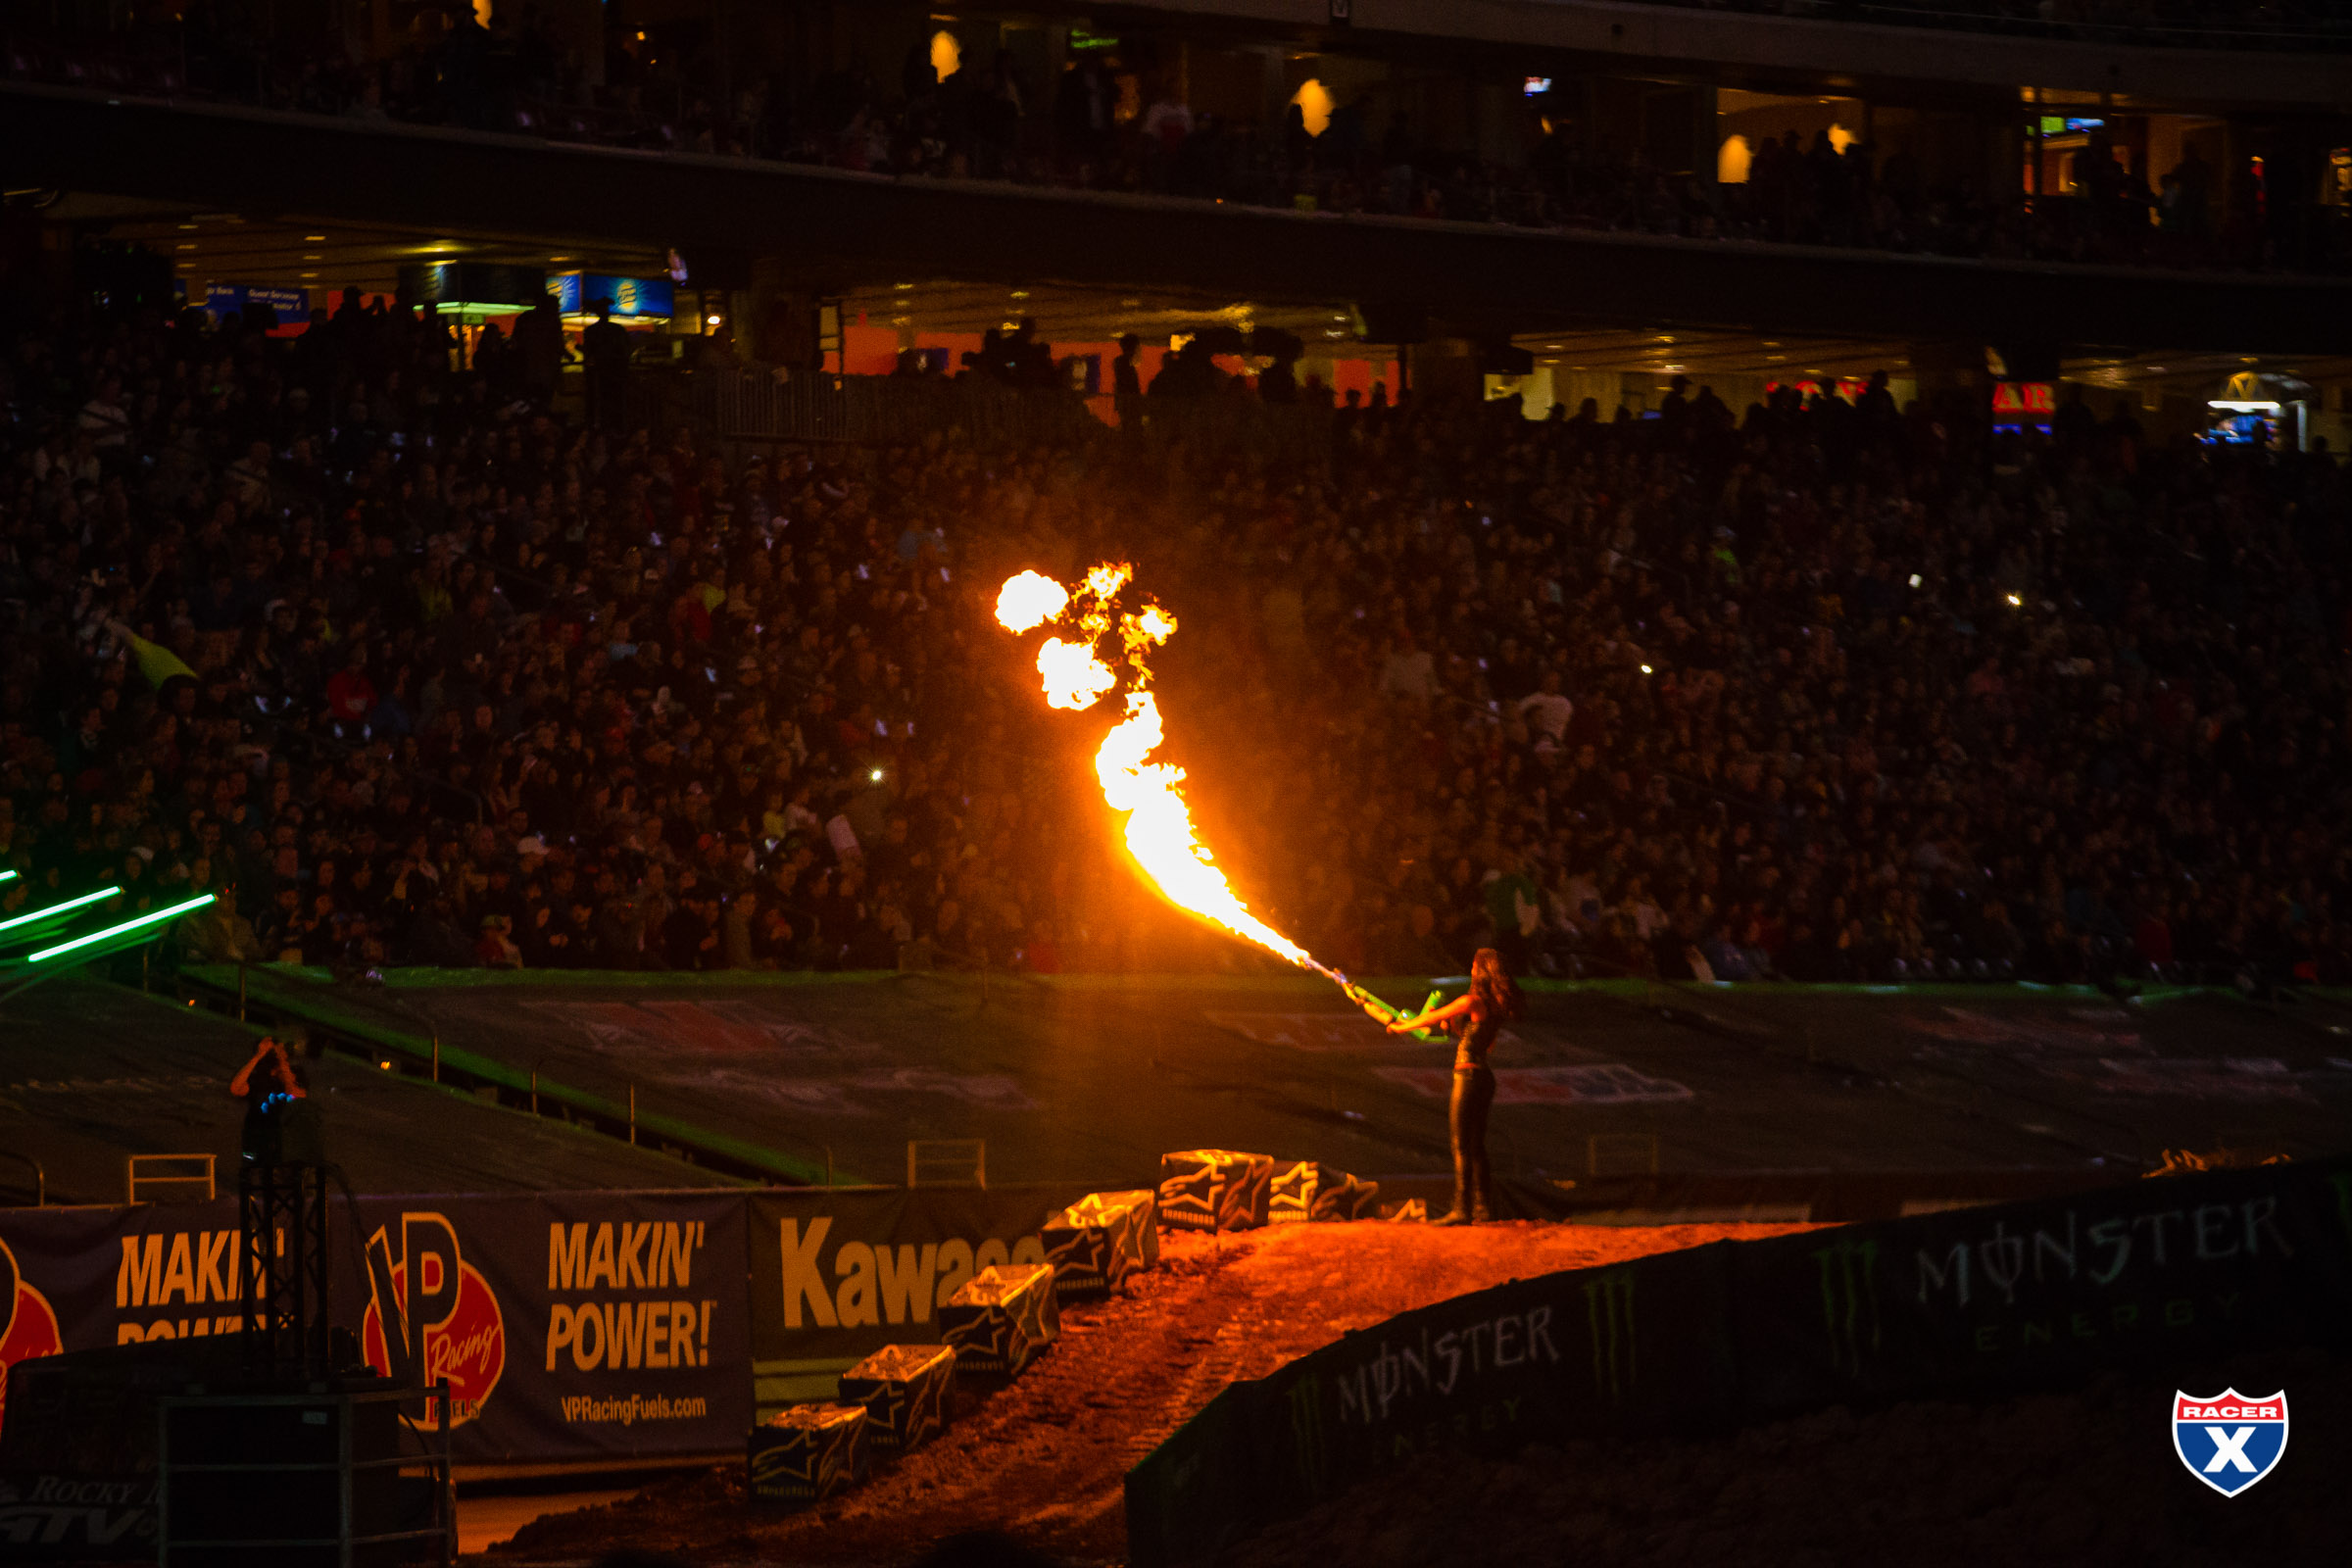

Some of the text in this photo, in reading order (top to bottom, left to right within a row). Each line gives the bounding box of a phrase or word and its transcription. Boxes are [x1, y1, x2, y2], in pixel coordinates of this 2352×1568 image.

[548, 1220, 706, 1291] MAKIN'
[780, 1216, 1047, 1329] Kawa
[430, 1321, 502, 1387] Racing
[545, 1299, 717, 1372] POWER!
[433, 1398, 480, 1420] ELS
[561, 1392, 707, 1427] VPRacingFuels.com
